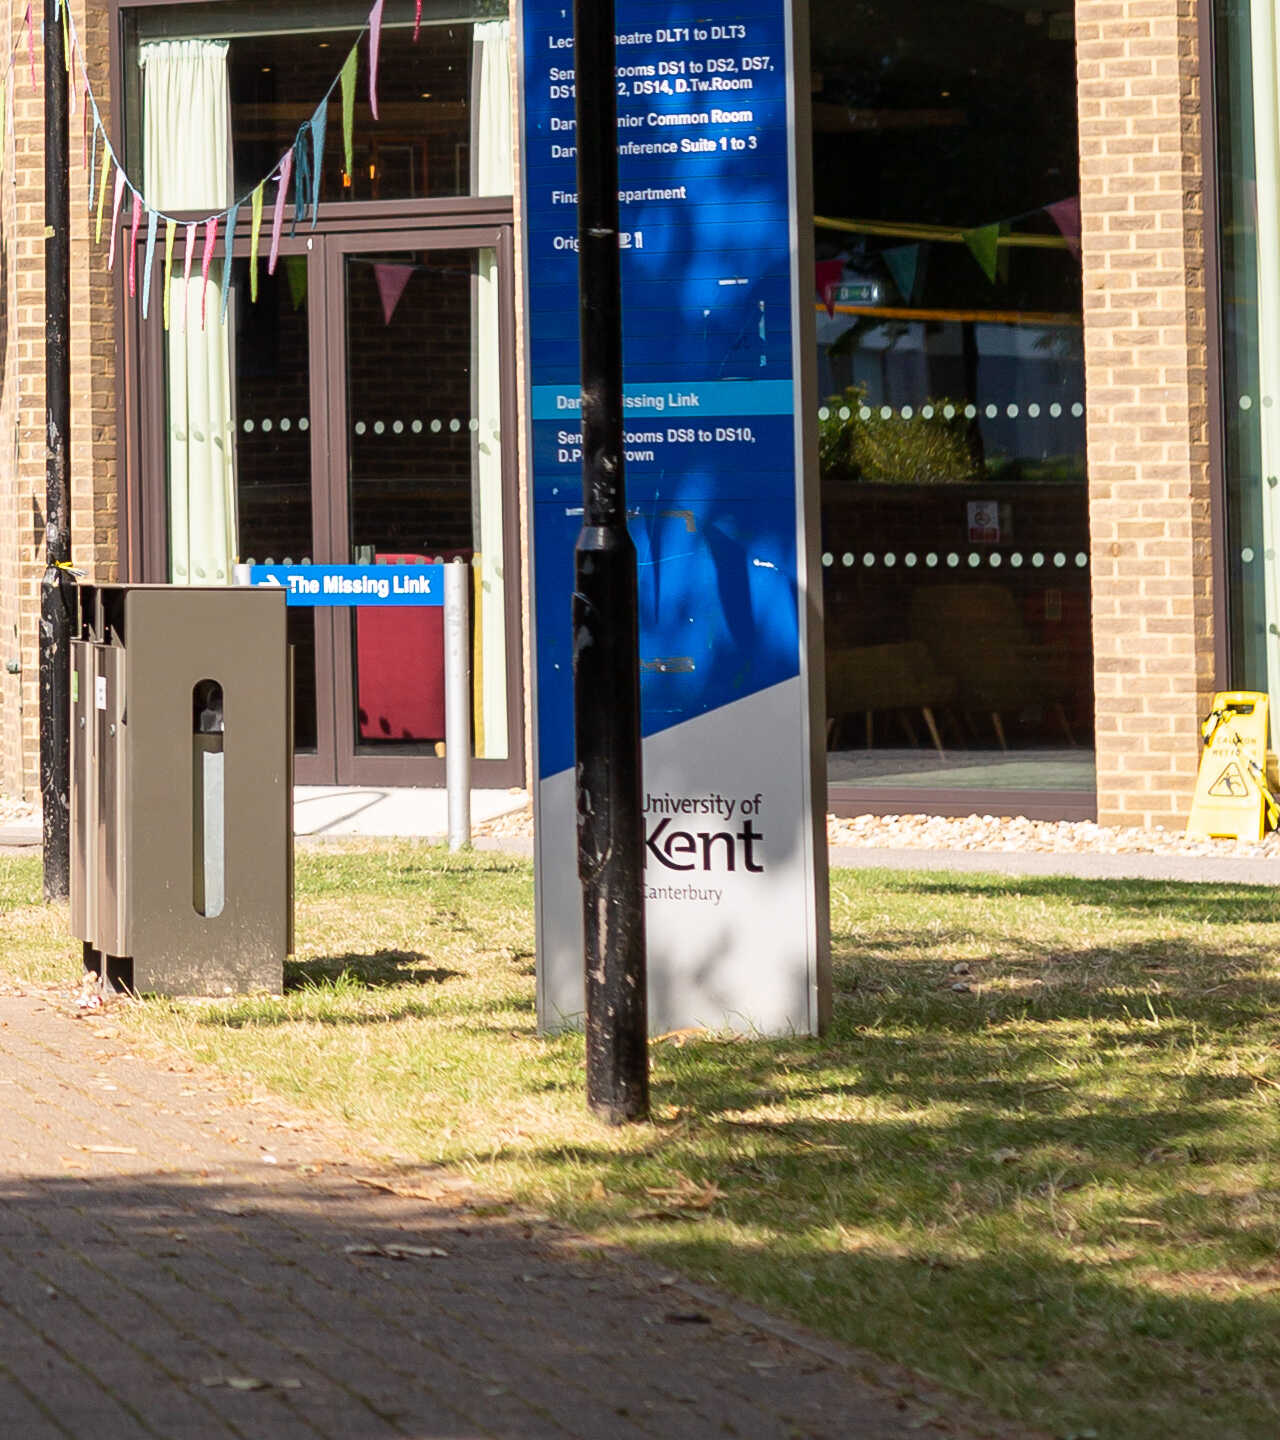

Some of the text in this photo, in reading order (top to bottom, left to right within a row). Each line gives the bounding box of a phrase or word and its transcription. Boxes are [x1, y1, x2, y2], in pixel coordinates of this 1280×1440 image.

[615, 24, 746, 45] eatre DLT1 to DLT3
[658, 60, 686, 76] DS1
[689, 61, 704, 74] to
[706, 58, 739, 74] DS2,
[742, 56, 775, 72] DS7,
[633, 79, 674, 96] DS14,
[550, 108, 754, 131] Dar nior Common Room
[551, 135, 758, 159] Dar nference Suite 1 to 3
[551, 185, 687, 205] Fina epartment
[556, 391, 700, 411] Dar issing Link
[667, 428, 696, 443] DS8
[698, 429, 713, 442] to
[715, 427, 756, 443] DS10,
[624, 450, 654, 462] own
[287, 575, 431, 599] The Missing Link
[641, 793, 763, 821] University of
[641, 817, 764, 873] Kent
